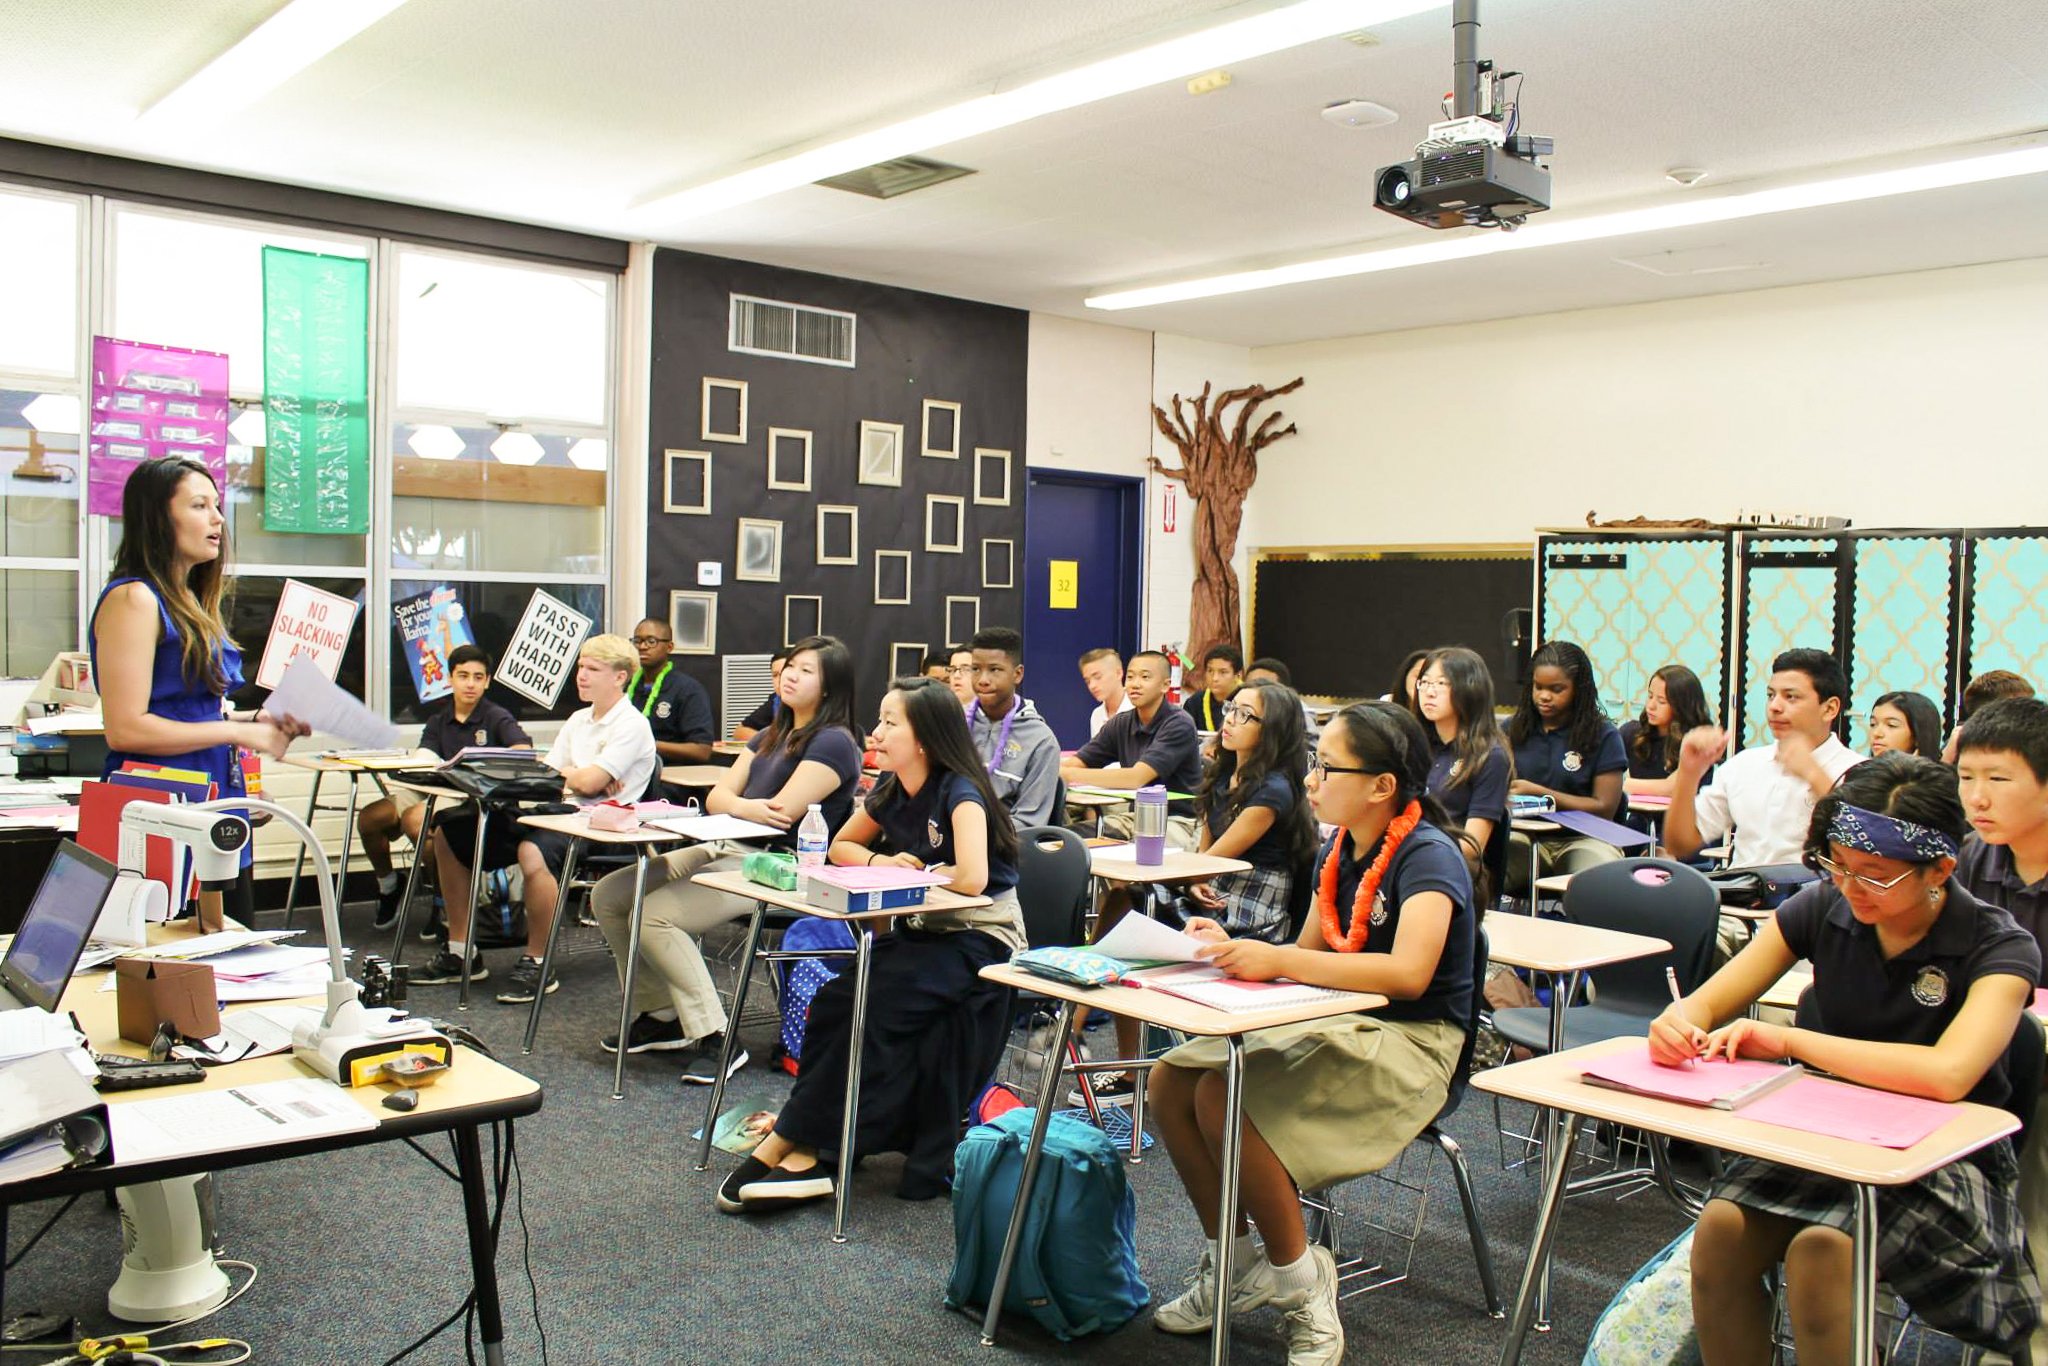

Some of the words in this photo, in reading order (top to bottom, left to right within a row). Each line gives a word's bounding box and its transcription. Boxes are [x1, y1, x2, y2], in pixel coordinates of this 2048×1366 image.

[1057, 579, 1070, 592] 32
[307, 601, 328, 622] NO
[394, 603, 416, 619] Save
[414, 598, 430, 611] the
[400, 615, 413, 629] for
[536, 603, 579, 638] PASS
[278, 615, 343, 651] SLACKING
[528, 622, 570, 657] WITH
[516, 640, 562, 676] HARD
[507, 658, 555, 696] WORK
[220, 826, 239, 837] 12x
